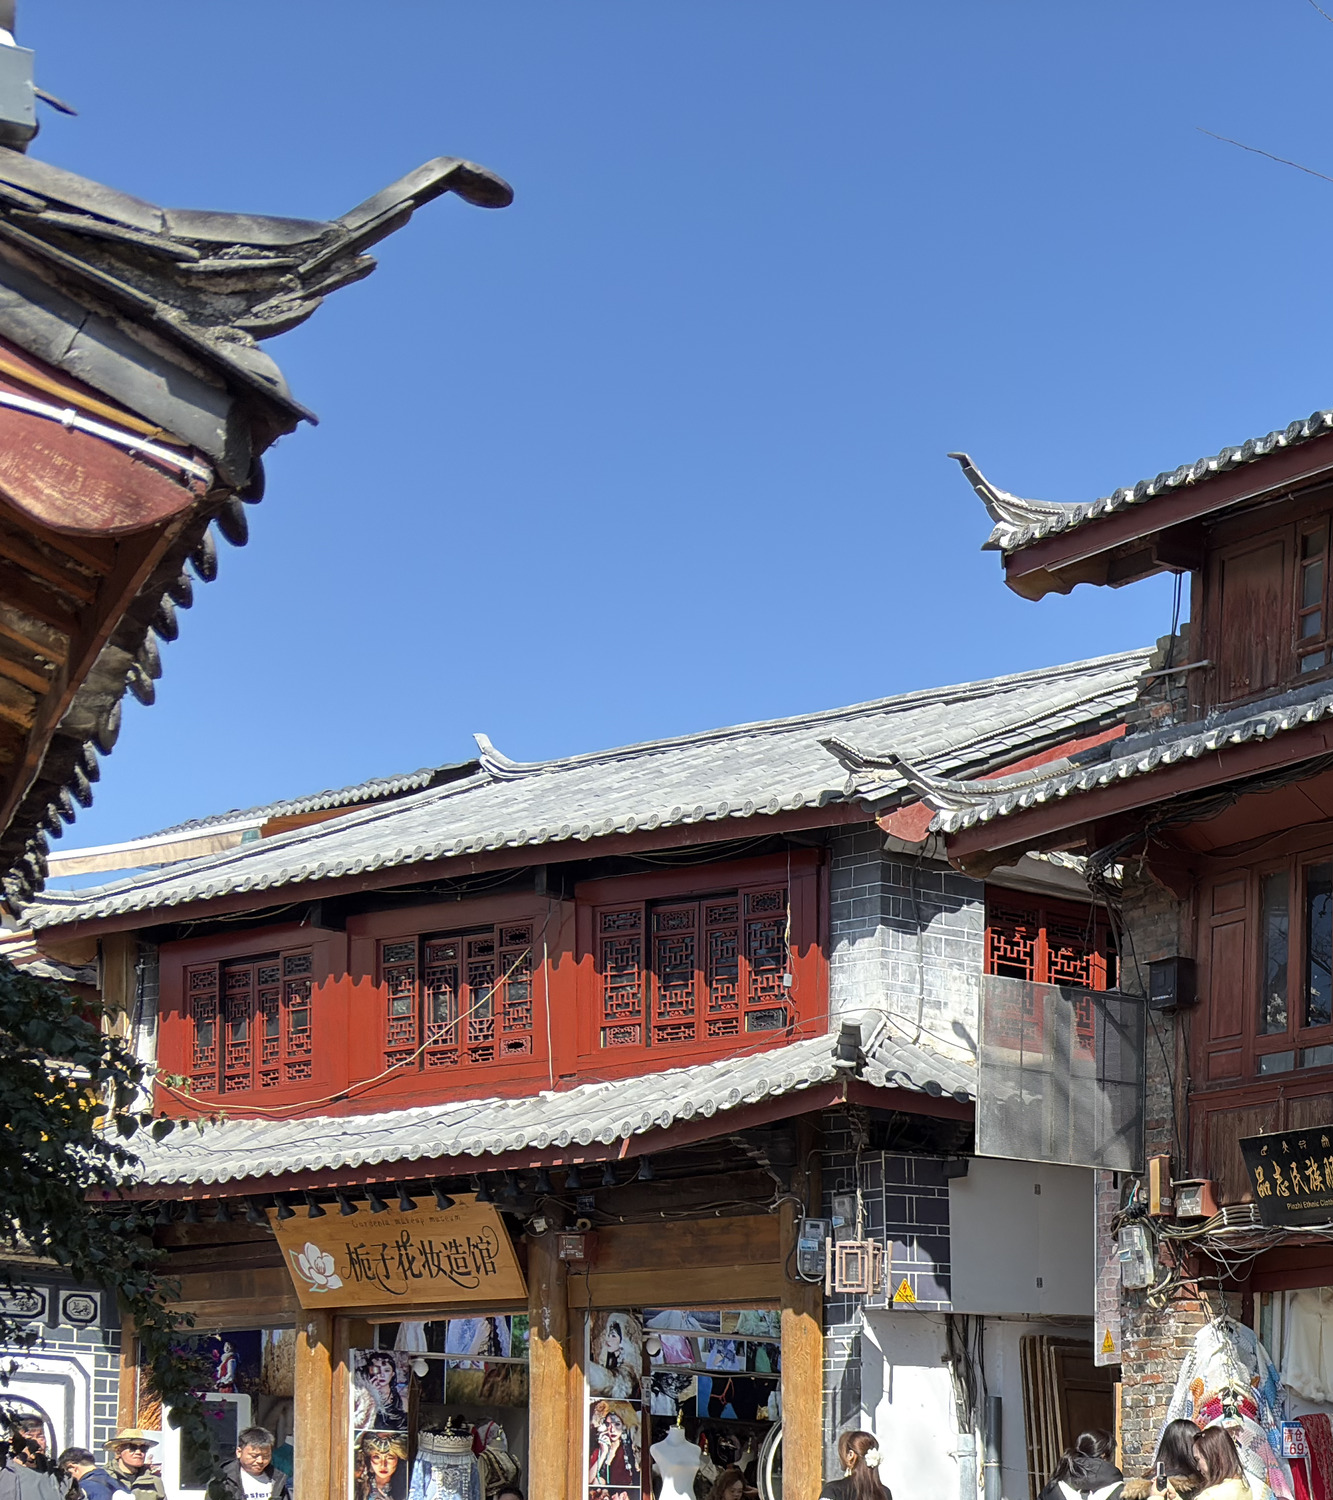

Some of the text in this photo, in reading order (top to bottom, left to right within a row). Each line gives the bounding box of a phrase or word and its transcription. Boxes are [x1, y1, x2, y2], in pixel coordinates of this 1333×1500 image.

[1303, 1199, 1319, 1209] Ethnic
[342, 1227, 499, 1292] 栀子花妆造馆
[1284, 1425, 1305, 1442] 清仓
